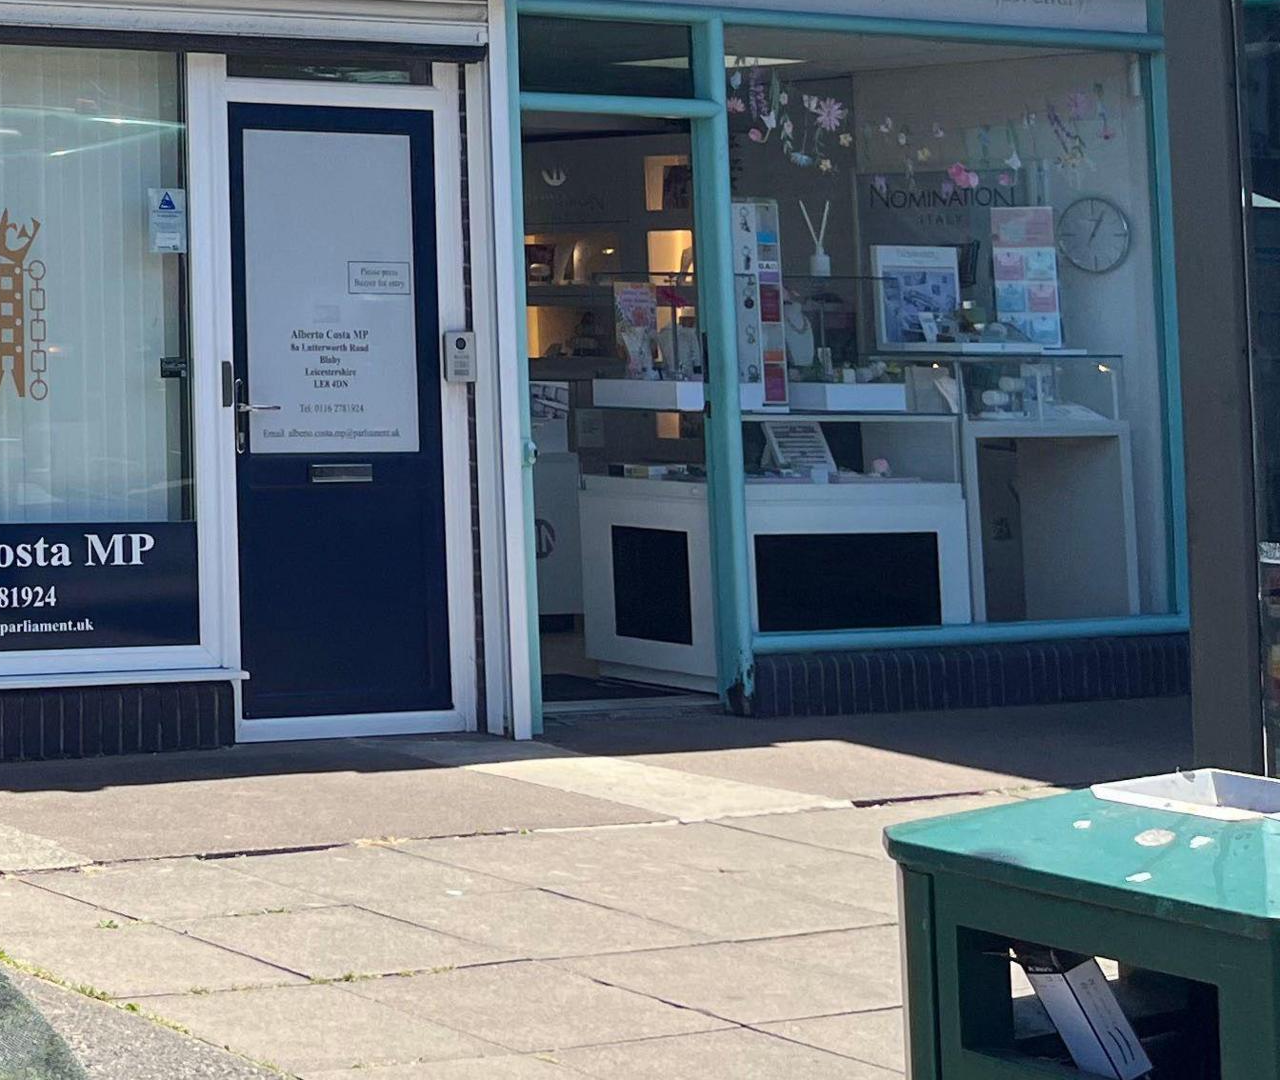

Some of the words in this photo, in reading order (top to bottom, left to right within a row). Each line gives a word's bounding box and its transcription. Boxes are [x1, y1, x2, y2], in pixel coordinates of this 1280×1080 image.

[291, 329, 324, 340] Alberto
[326, 329, 351, 340] Costa
[353, 329, 369, 340] MP
[84, 533, 155, 566] MP
